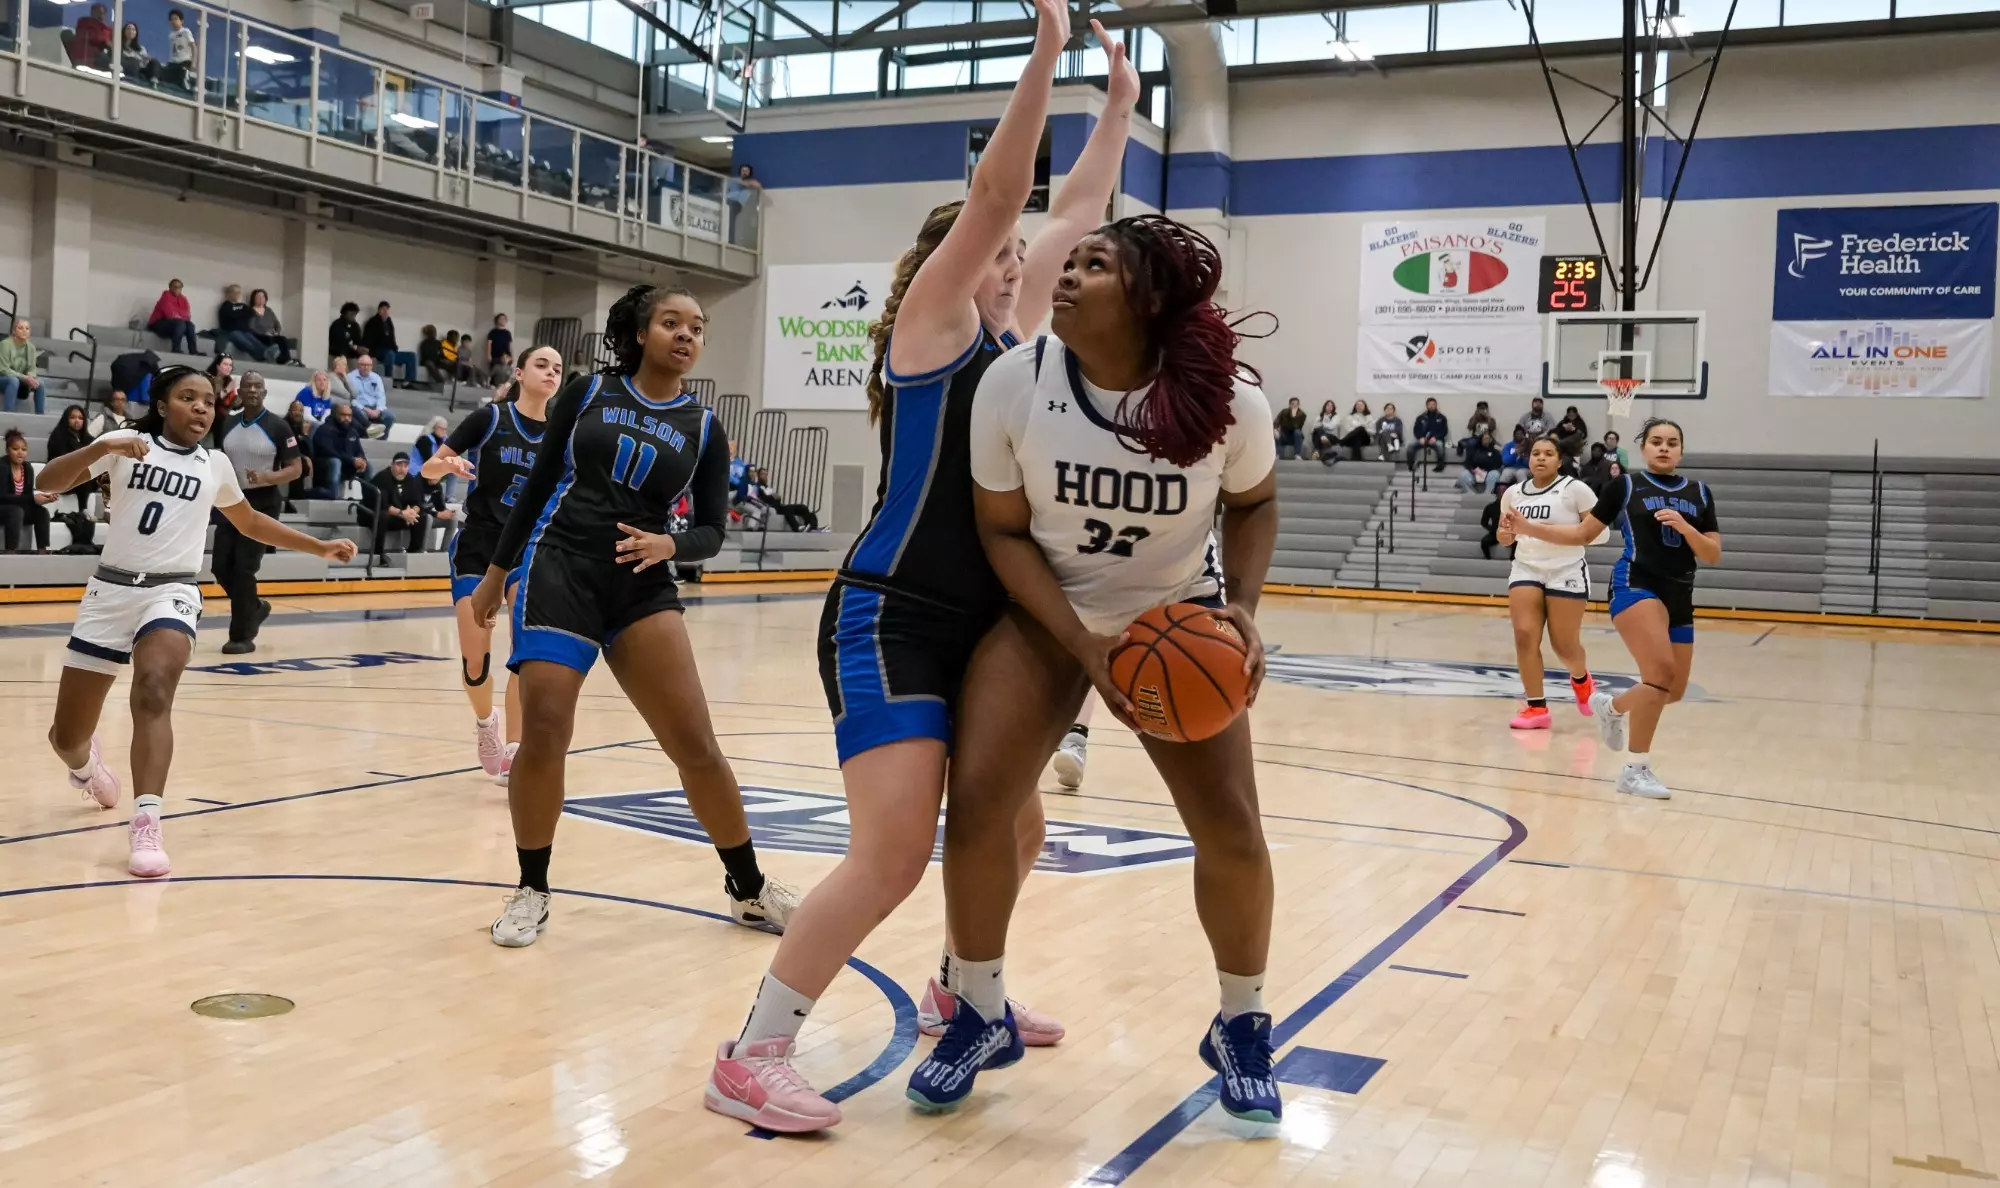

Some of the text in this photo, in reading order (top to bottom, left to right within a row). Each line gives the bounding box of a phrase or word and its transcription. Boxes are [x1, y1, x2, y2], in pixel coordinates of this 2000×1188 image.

[1384, 226, 1398, 236] GO
[1487, 227, 1538, 247] BLAZERS!
[1508, 222, 1523, 232] GO
[1369, 231, 1418, 252] BLAZERS!
[1841, 231, 1970, 254] Frederick
[1555, 261, 1596, 279] 2:35
[1840, 254, 1921, 275] Health
[1550, 280, 1587, 308] 25
[1839, 286, 1981, 297] YOUR COMMUNITY OF CARE
[1445, 303, 1525, 315] paisanospizza.com
[1438, 346, 1491, 355] SPORTS
[1811, 346, 1949, 359] ALL IN ONE
[804, 367, 869, 386] AREN
[602, 406, 687, 454] WILSON
[500, 446, 537, 470] WILS
[611, 433, 657, 491] 11
[127, 462, 202, 502] HOOD
[1054, 460, 1188, 516] HOOD
[137, 500, 165, 536] 0
[1516, 504, 1551, 520] OOD
[1076, 517, 1152, 557] 32
